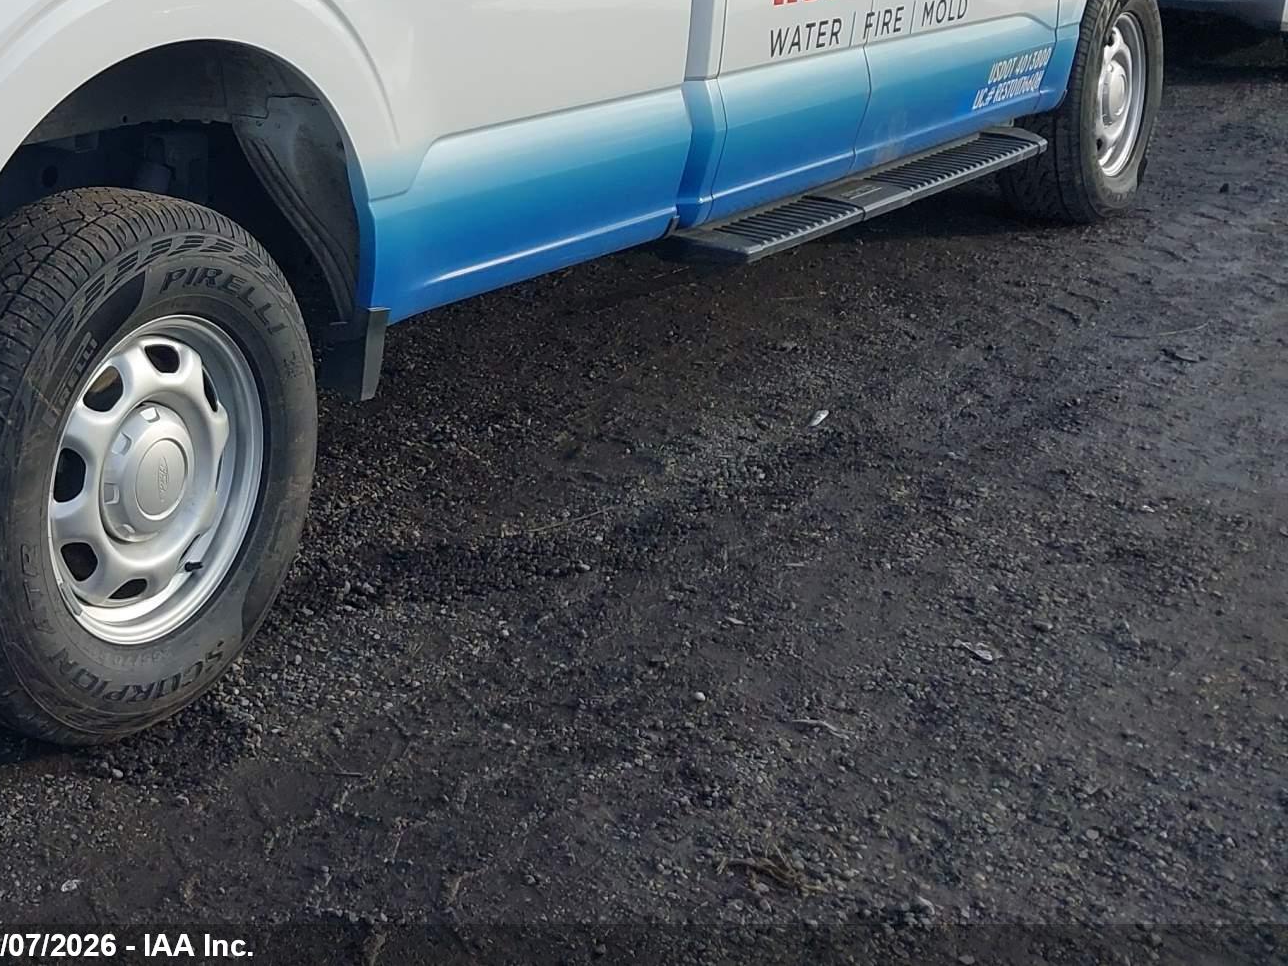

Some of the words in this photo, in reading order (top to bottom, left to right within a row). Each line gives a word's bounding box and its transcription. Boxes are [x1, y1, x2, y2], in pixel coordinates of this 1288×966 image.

[770, 18, 843, 57] WATER
[863, 6, 905, 39] FIRE
[988, 56, 1018, 85] USDOT
